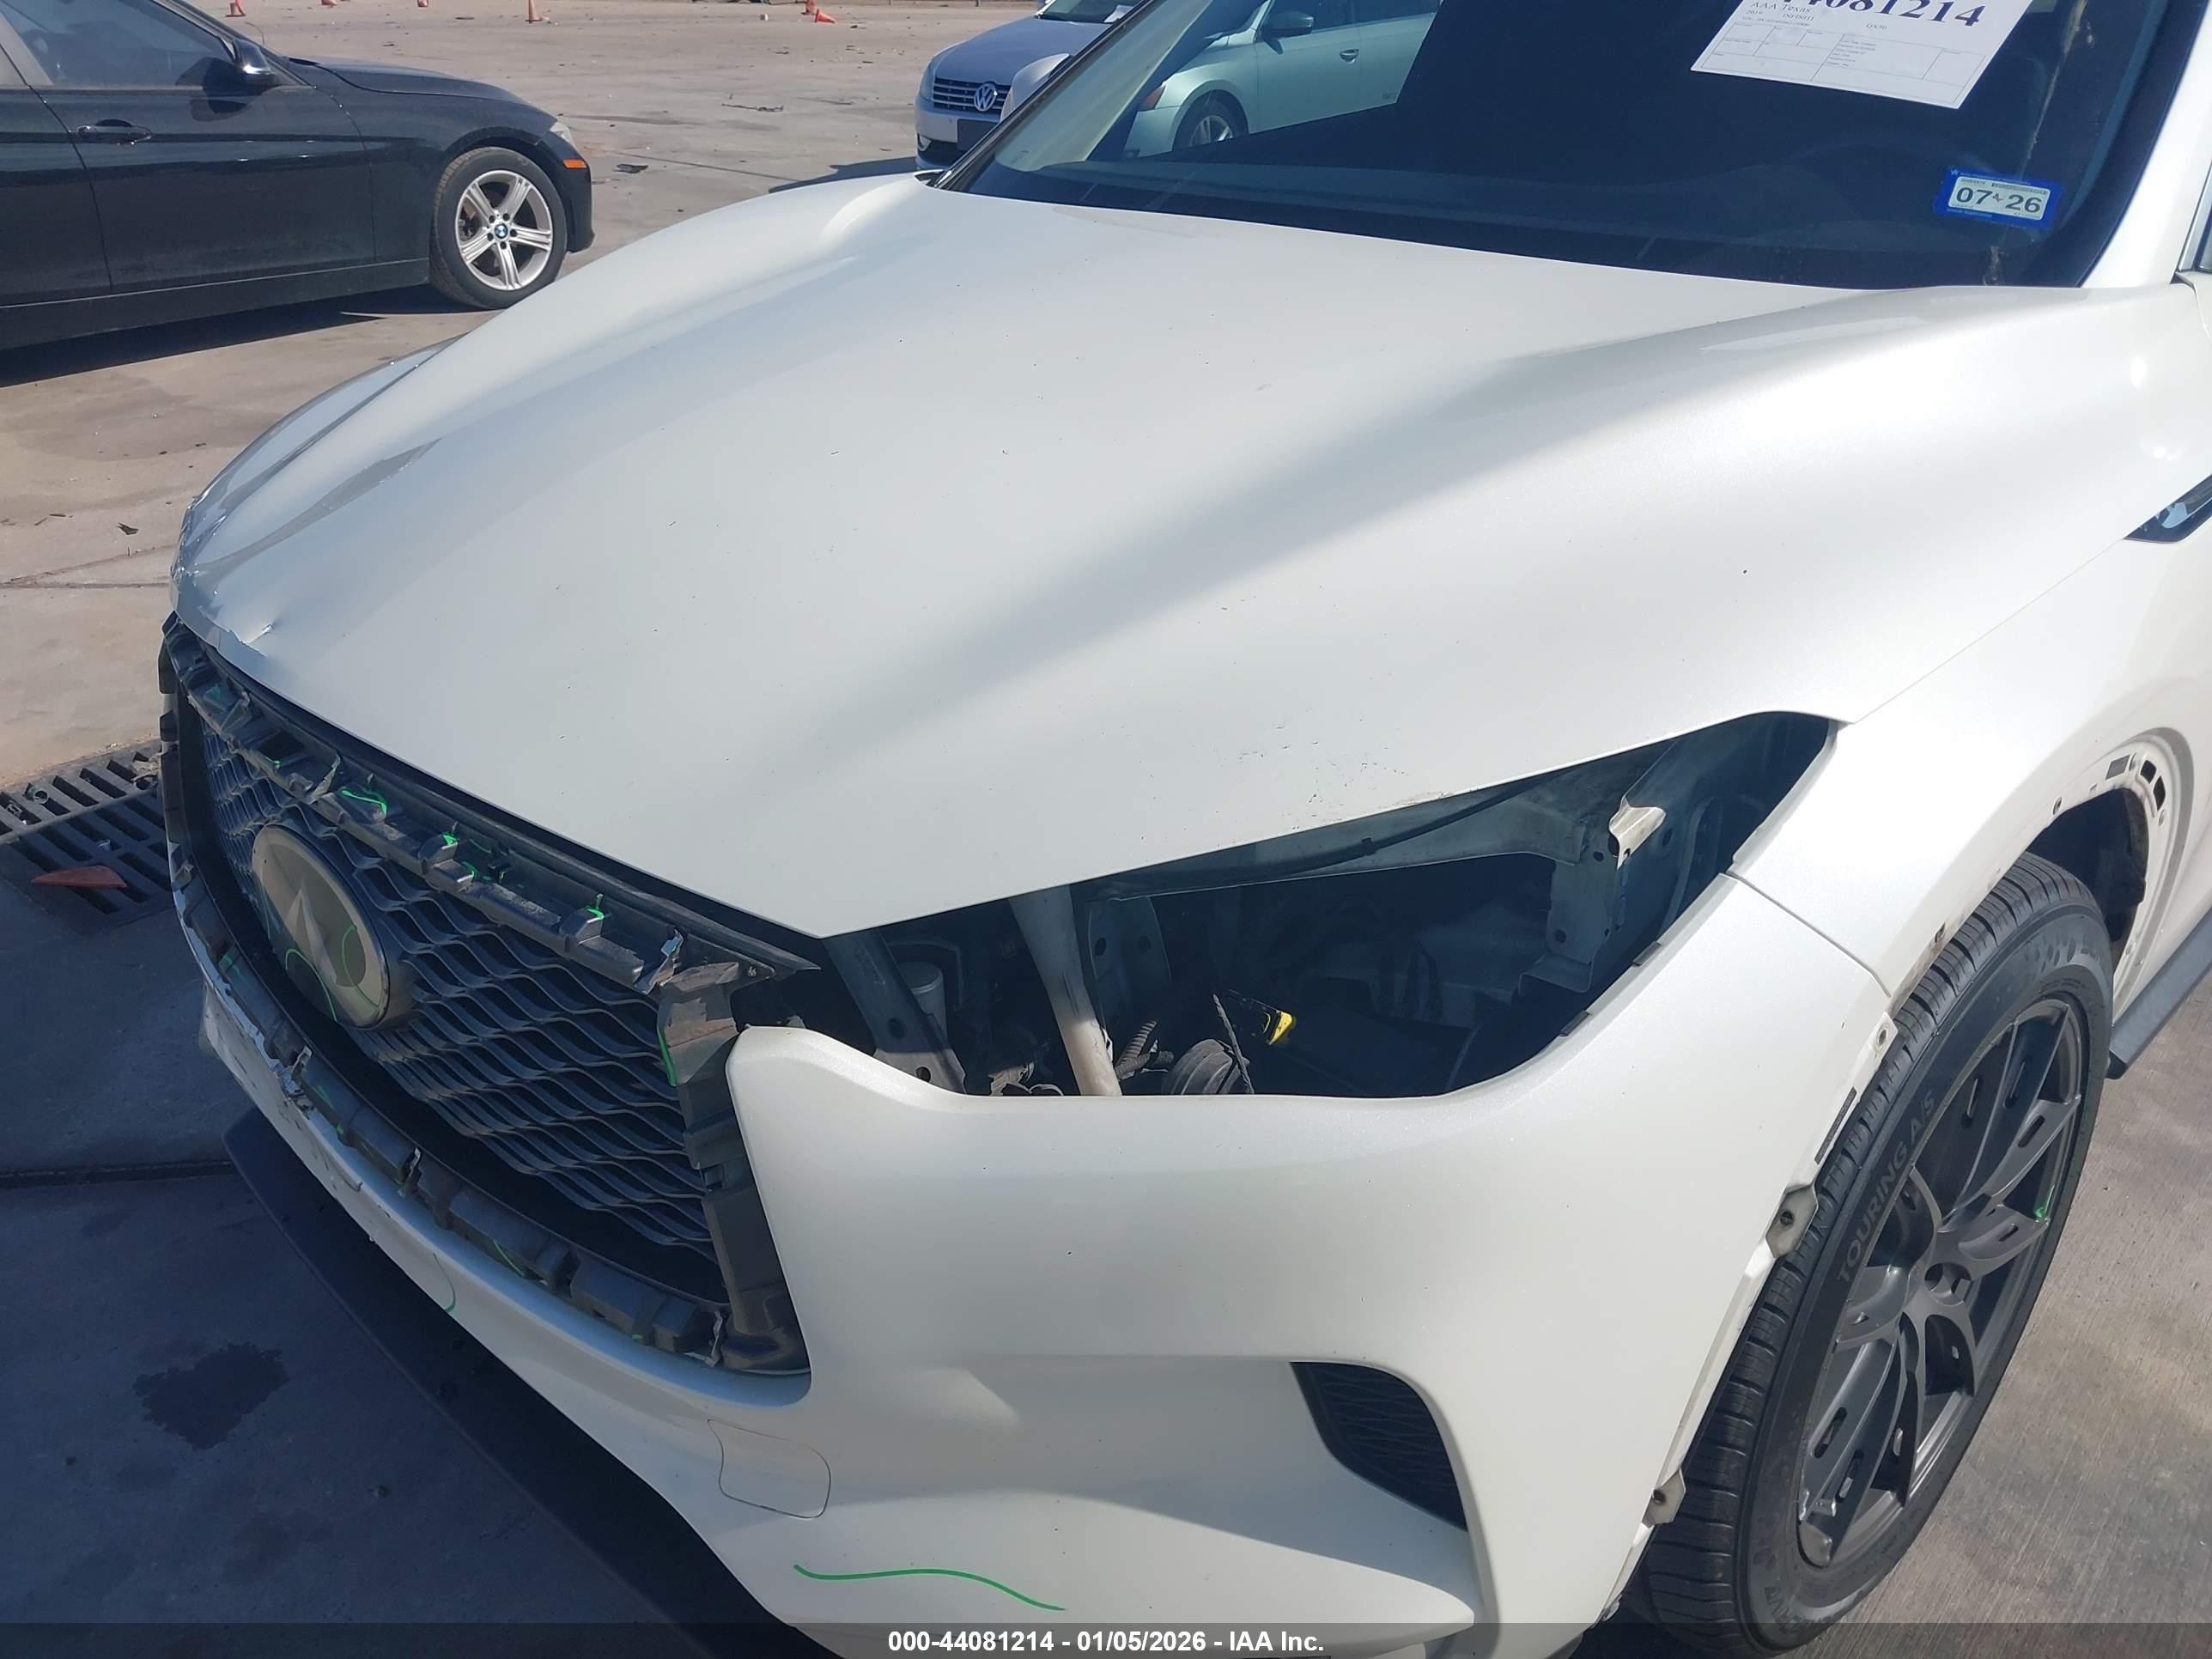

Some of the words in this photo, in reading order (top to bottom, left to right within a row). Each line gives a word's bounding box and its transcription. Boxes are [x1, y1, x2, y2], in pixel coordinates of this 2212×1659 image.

[1784, 0, 1985, 27] 81214
[1956, 187, 1992, 204] 07
[2005, 194, 2042, 214] 26
[1837, 1140, 1908, 1283] TOURING
[1910, 1090, 1936, 1144] A/S
